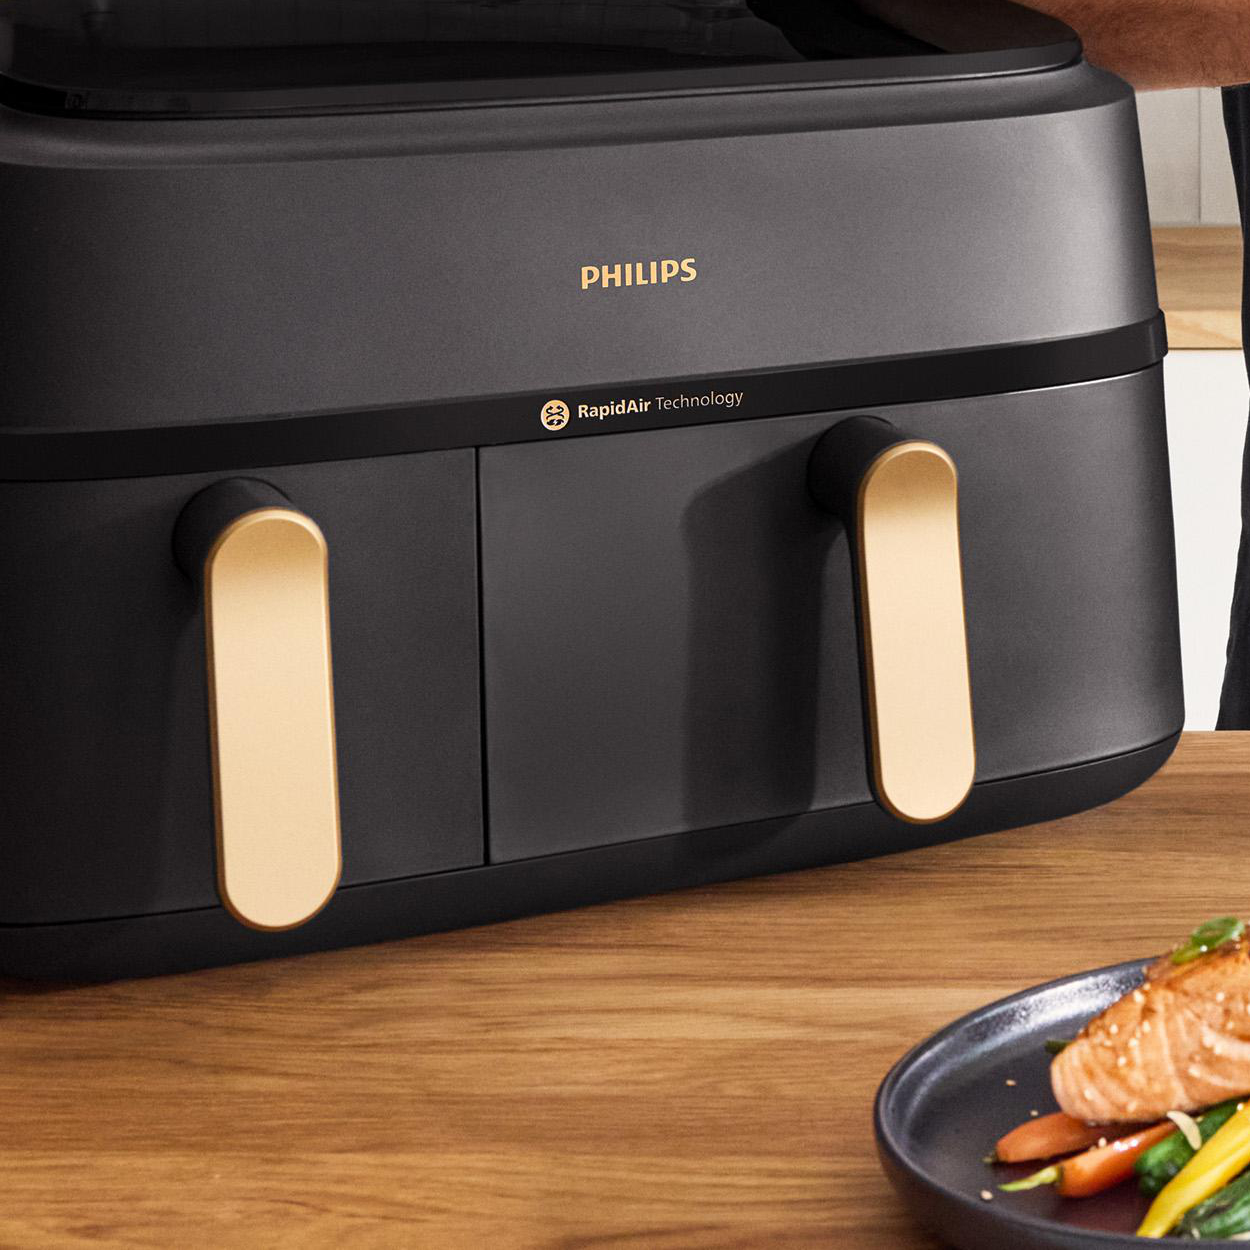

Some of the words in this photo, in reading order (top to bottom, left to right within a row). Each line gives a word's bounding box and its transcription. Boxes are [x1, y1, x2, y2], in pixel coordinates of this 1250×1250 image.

[580, 257, 697, 290] PHILIPS
[577, 398, 651, 419] RapidAir
[655, 390, 744, 411] Technology
